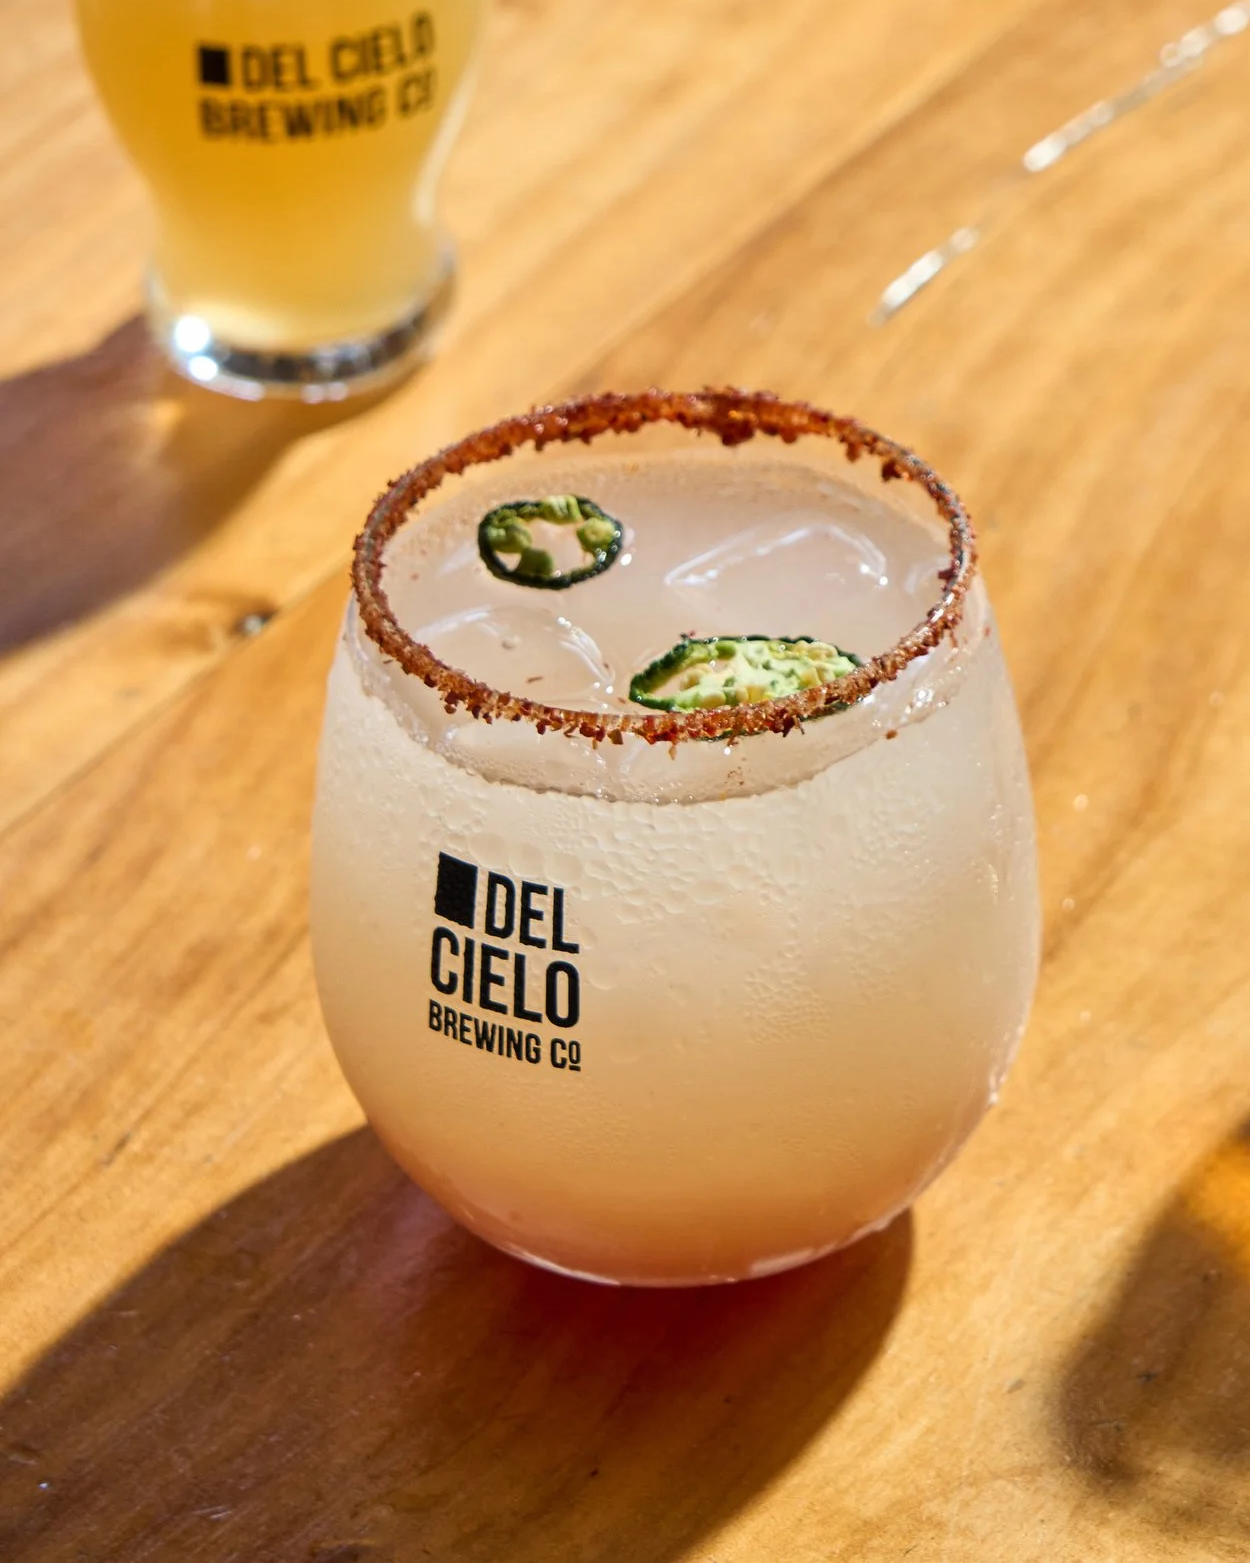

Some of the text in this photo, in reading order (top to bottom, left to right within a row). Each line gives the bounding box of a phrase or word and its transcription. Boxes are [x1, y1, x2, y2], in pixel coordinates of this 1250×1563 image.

[241, 11, 434, 92] DEL CIELO
[200, 85, 386, 145] BREWING
[485, 871, 580, 954] DEL
[431, 926, 580, 1028] CIELO
[429, 998, 542, 1064] BREWING
